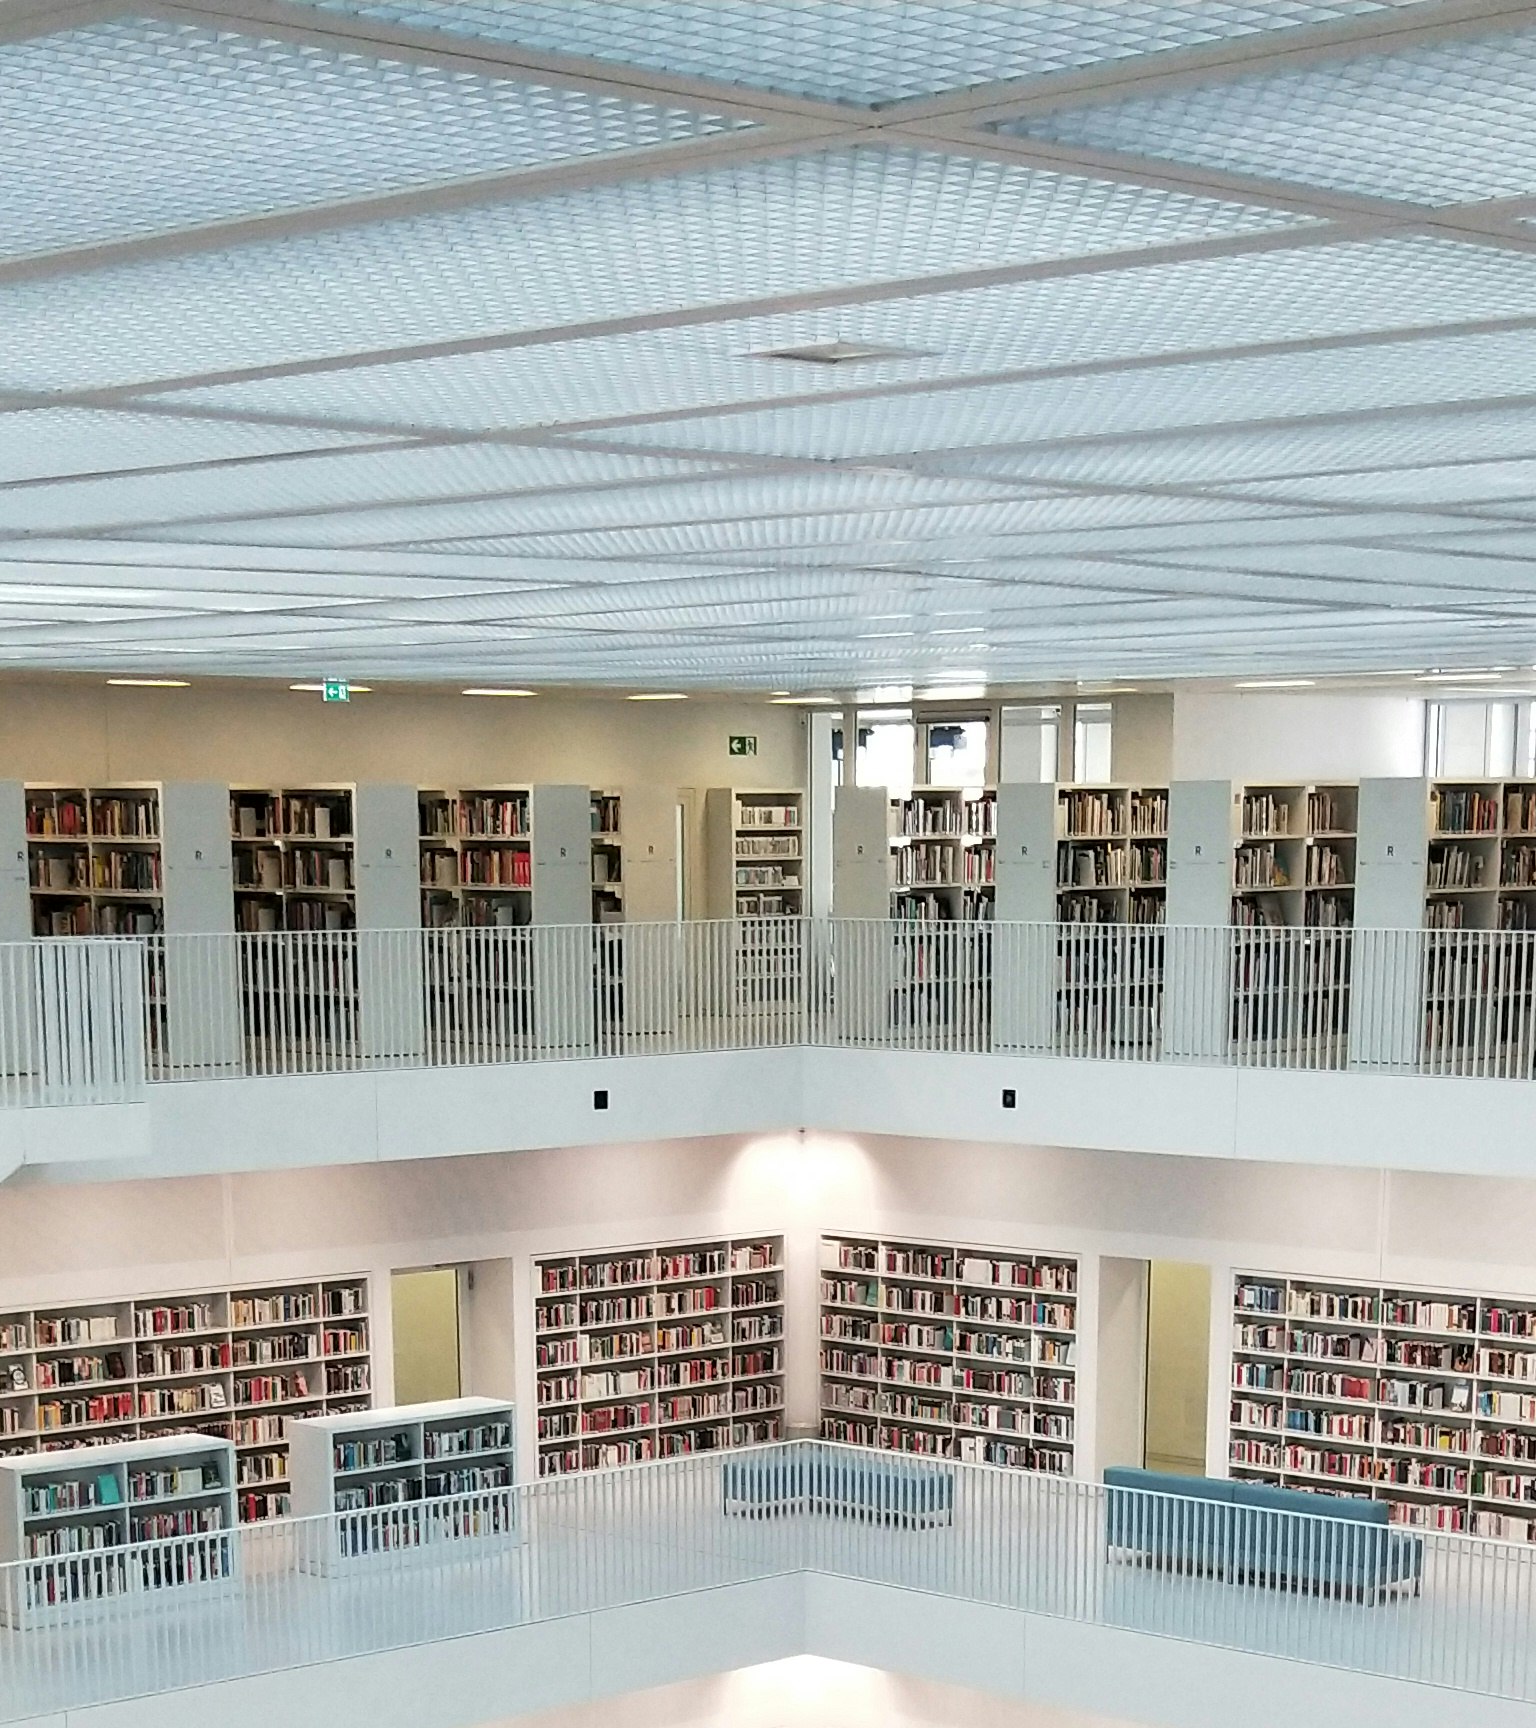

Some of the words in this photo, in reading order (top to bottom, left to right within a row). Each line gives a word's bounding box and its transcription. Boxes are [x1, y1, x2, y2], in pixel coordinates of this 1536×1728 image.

[17, 851, 23, 861] R
[1021, 846, 1027, 856] R
[1195, 846, 1201, 856] R
[1387, 846, 1393, 857] R
